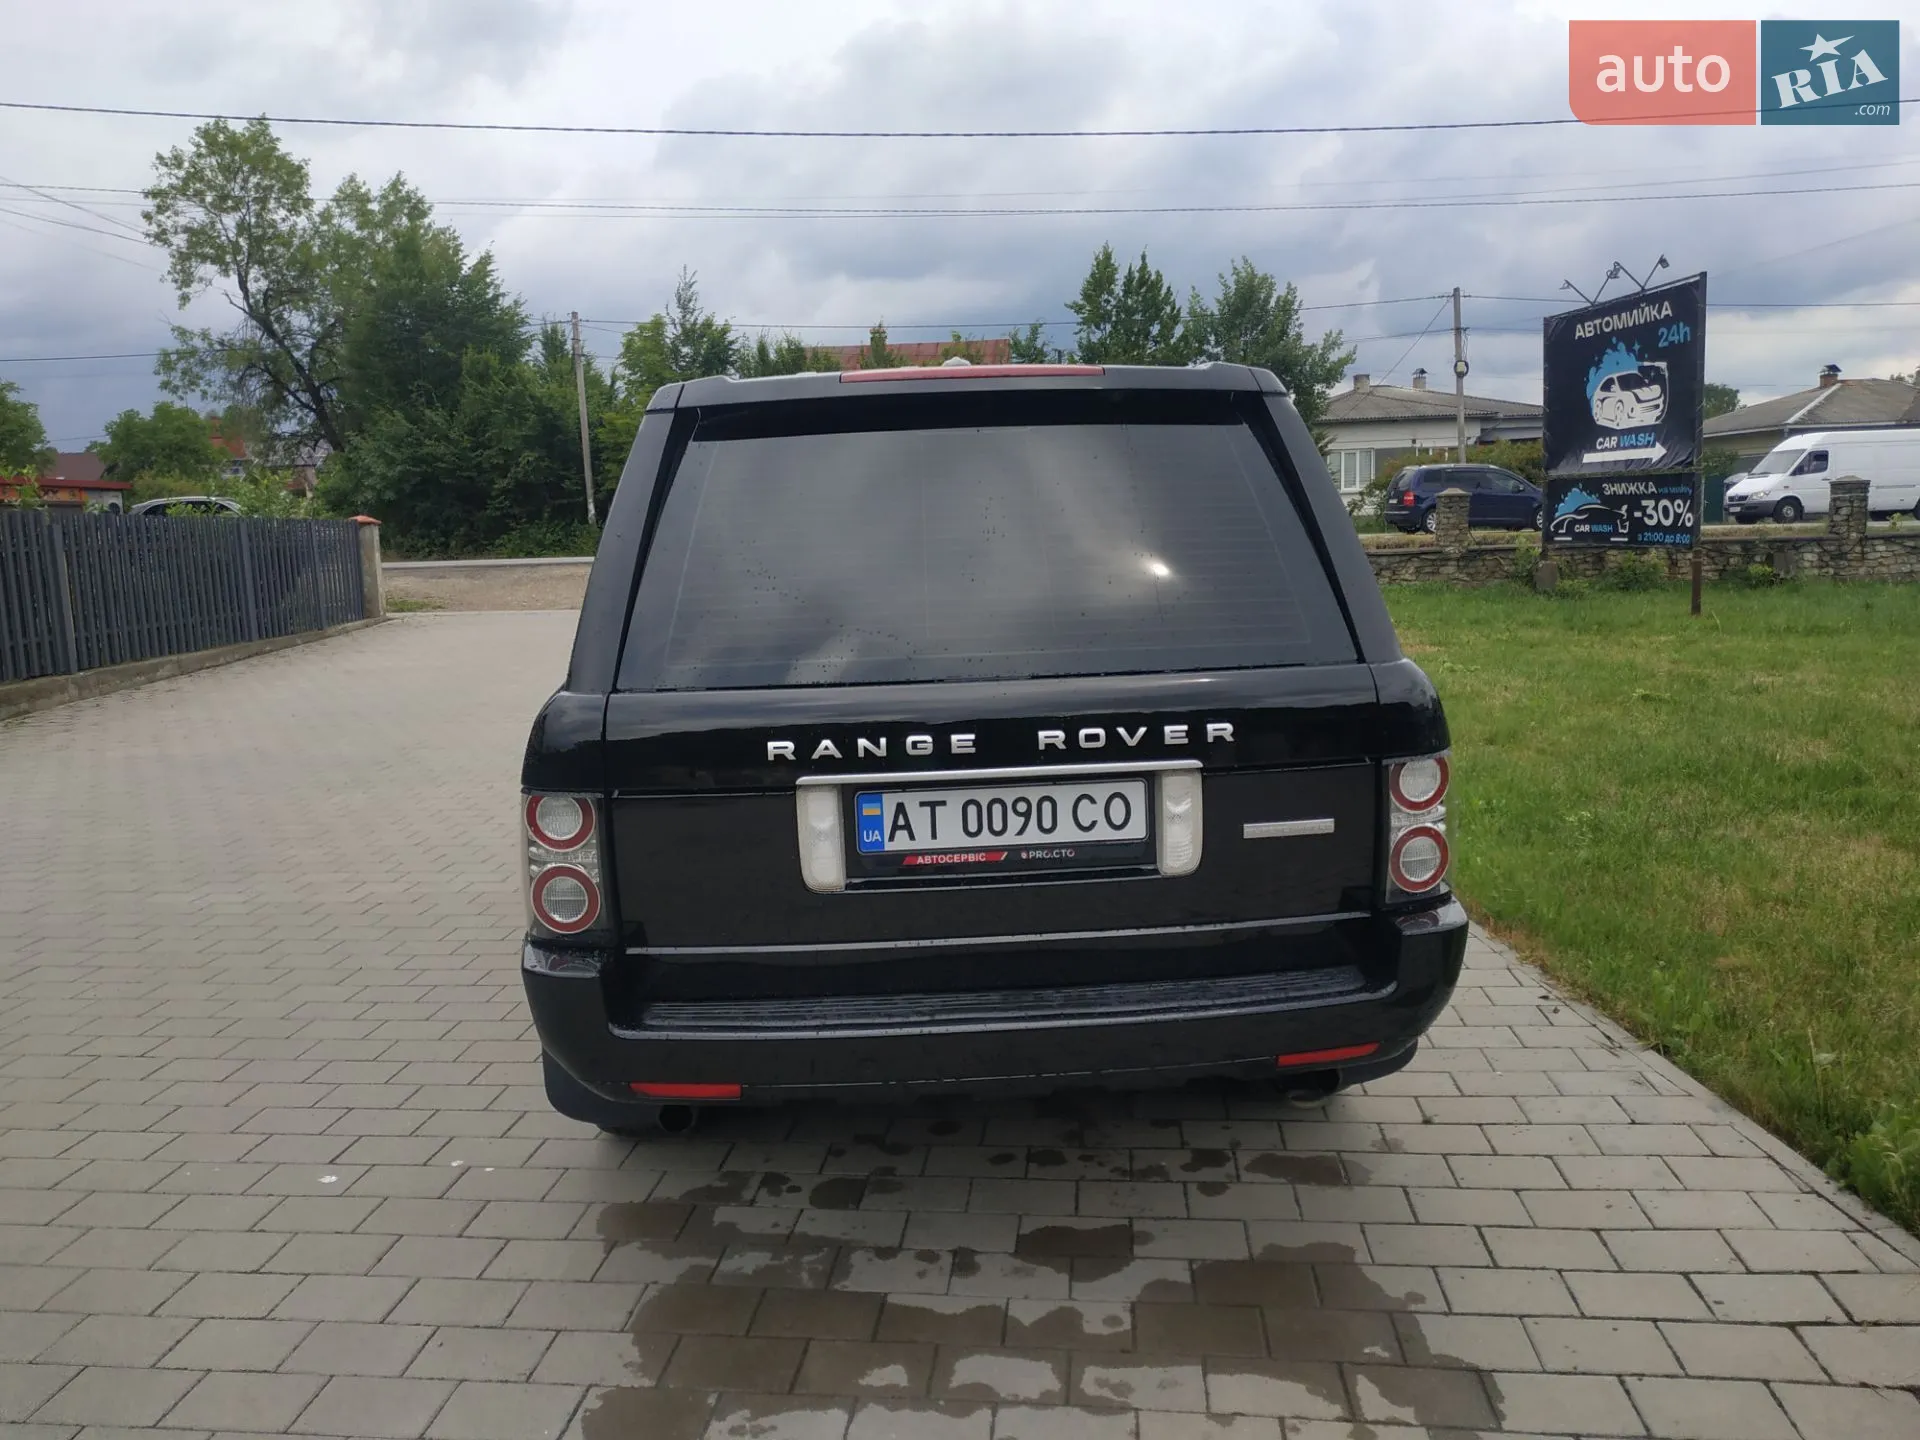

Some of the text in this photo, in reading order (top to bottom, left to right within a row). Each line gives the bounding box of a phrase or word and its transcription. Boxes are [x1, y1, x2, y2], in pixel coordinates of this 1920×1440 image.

[1575, 300, 1673, 340] АВТОМИЙКА
[1658, 321, 1691, 348] 24h
[1596, 432, 1655, 450] CAR WASH
[1601, 481, 1657, 496] ЗНИЖКА
[1633, 498, 1694, 528] -30%
[1574, 524, 1614, 533] CAR WASH
[1643, 531, 1664, 542] 21:00
[766, 722, 1236, 761] RANGE ROVER
[887, 791, 1132, 843] AT 0090 CO
[863, 830, 882, 843] UA
[916, 852, 986, 865] АВТОСЕРВІС
